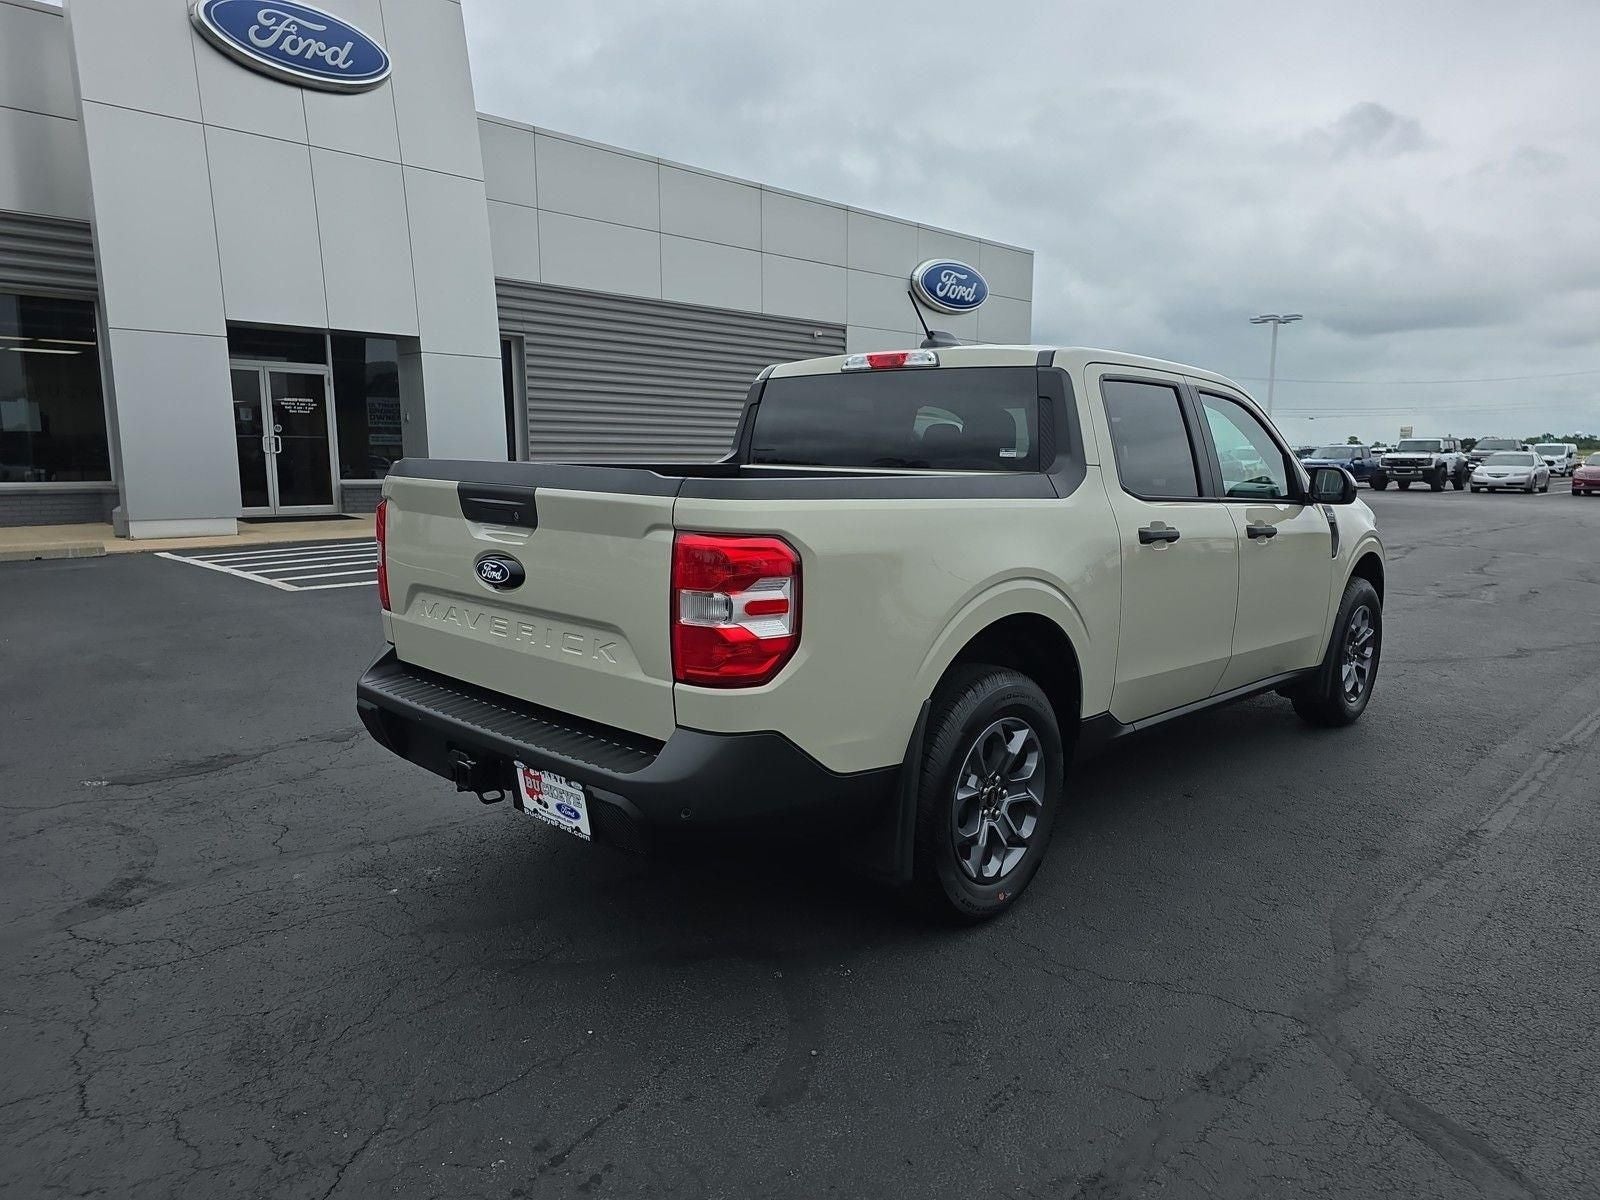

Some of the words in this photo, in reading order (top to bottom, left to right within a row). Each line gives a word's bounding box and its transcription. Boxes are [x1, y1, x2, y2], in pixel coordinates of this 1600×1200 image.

[248, 8, 353, 69] Ford
[936, 269, 977, 302] Ford
[481, 562, 504, 580] Ford
[421, 599, 617, 664] MAVERICK
[524, 775, 583, 808] BUCKEYE
[524, 807, 591, 841] BuckeyeFord.com
[560, 805, 576, 818] Ford
